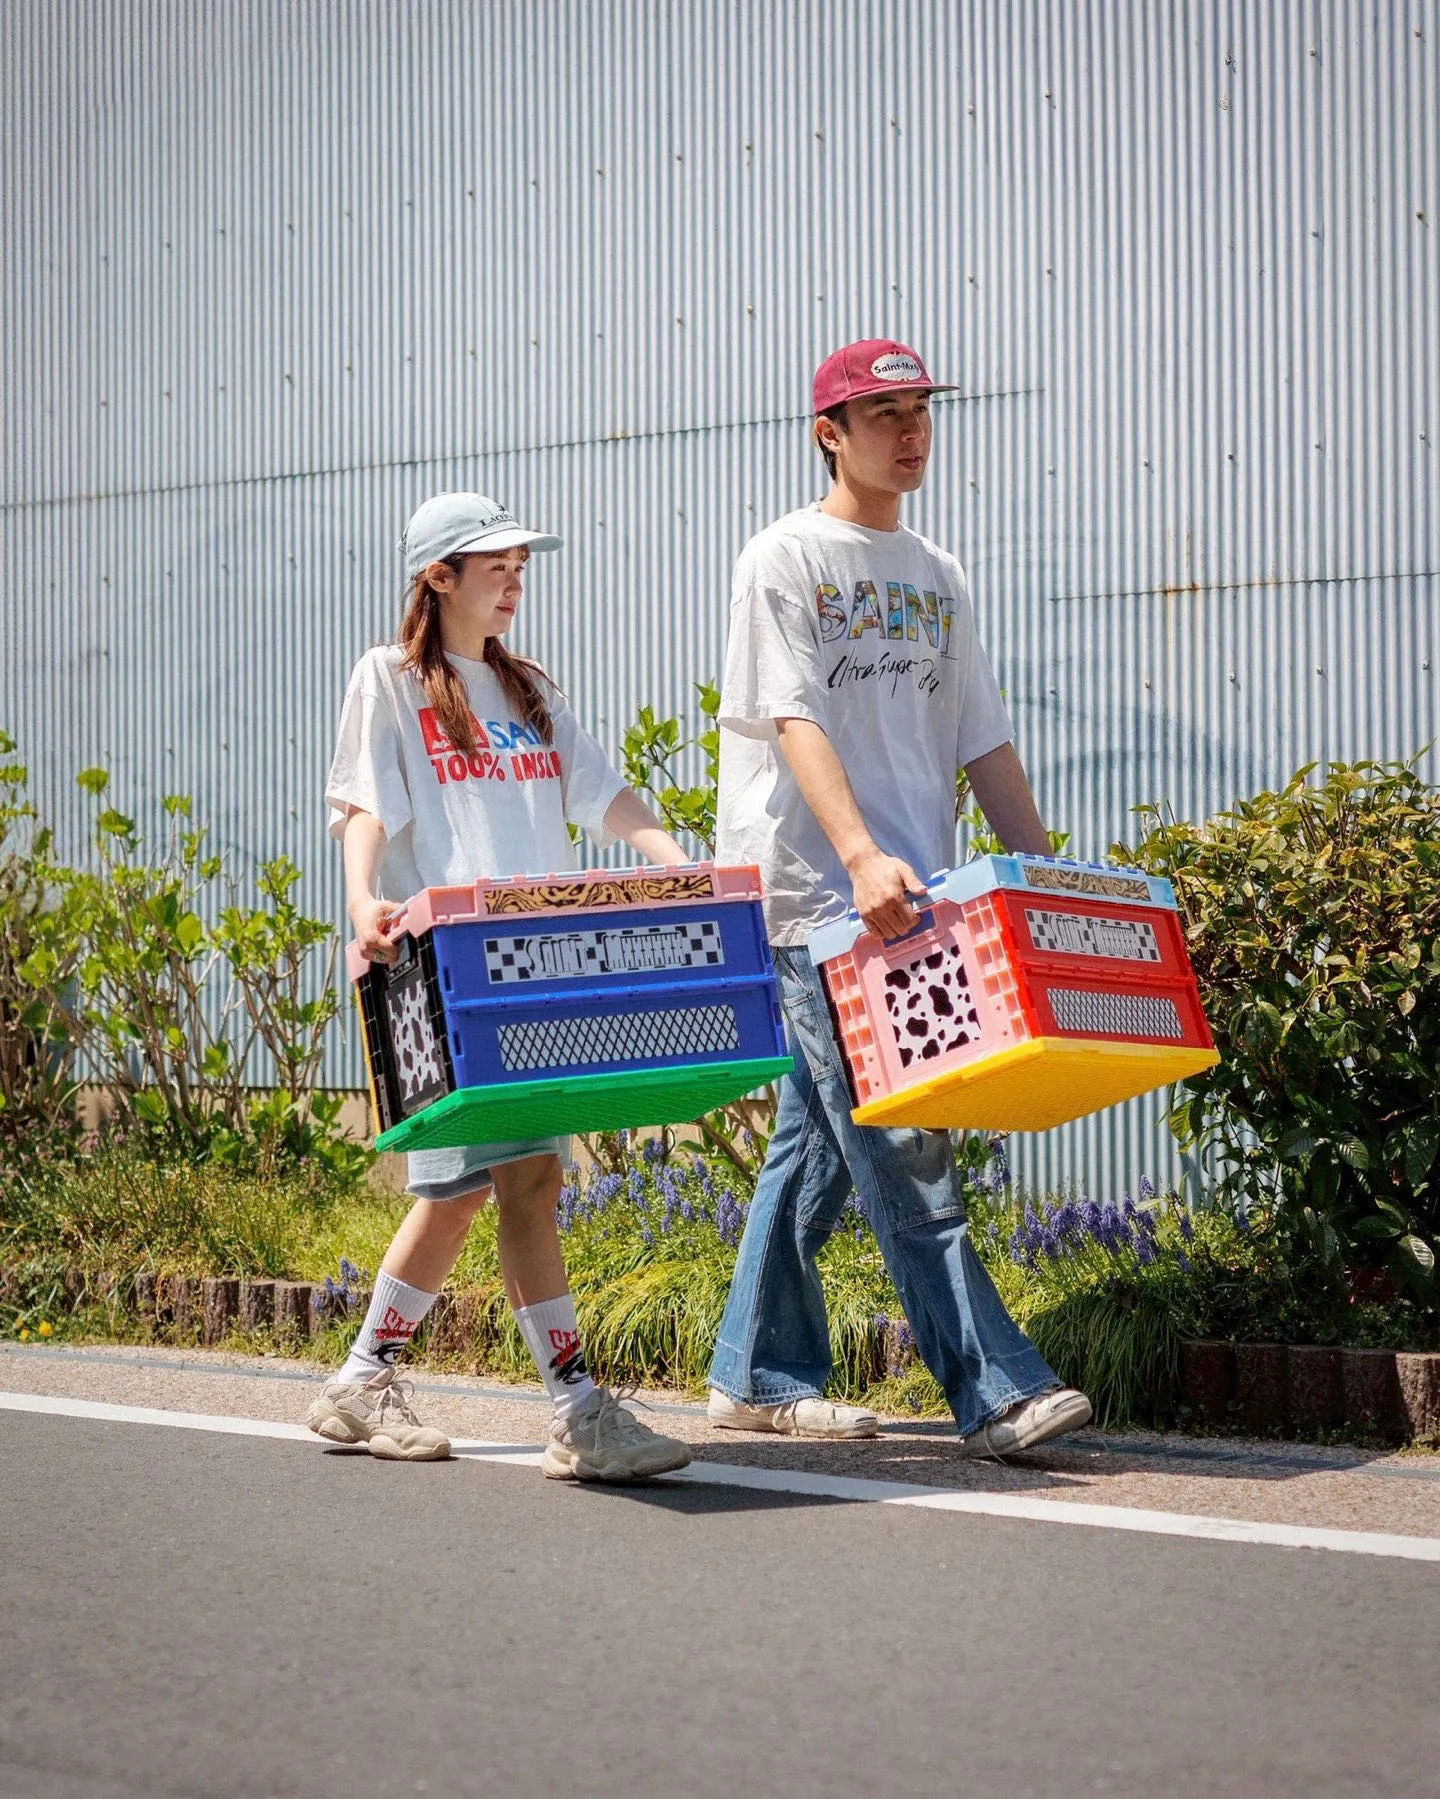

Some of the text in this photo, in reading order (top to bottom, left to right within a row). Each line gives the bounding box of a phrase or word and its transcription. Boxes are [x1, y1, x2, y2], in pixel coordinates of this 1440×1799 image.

[815, 580, 957, 660] SAINT
[431, 751, 506, 785] 100%
[525, 937, 588, 978] SAINT
